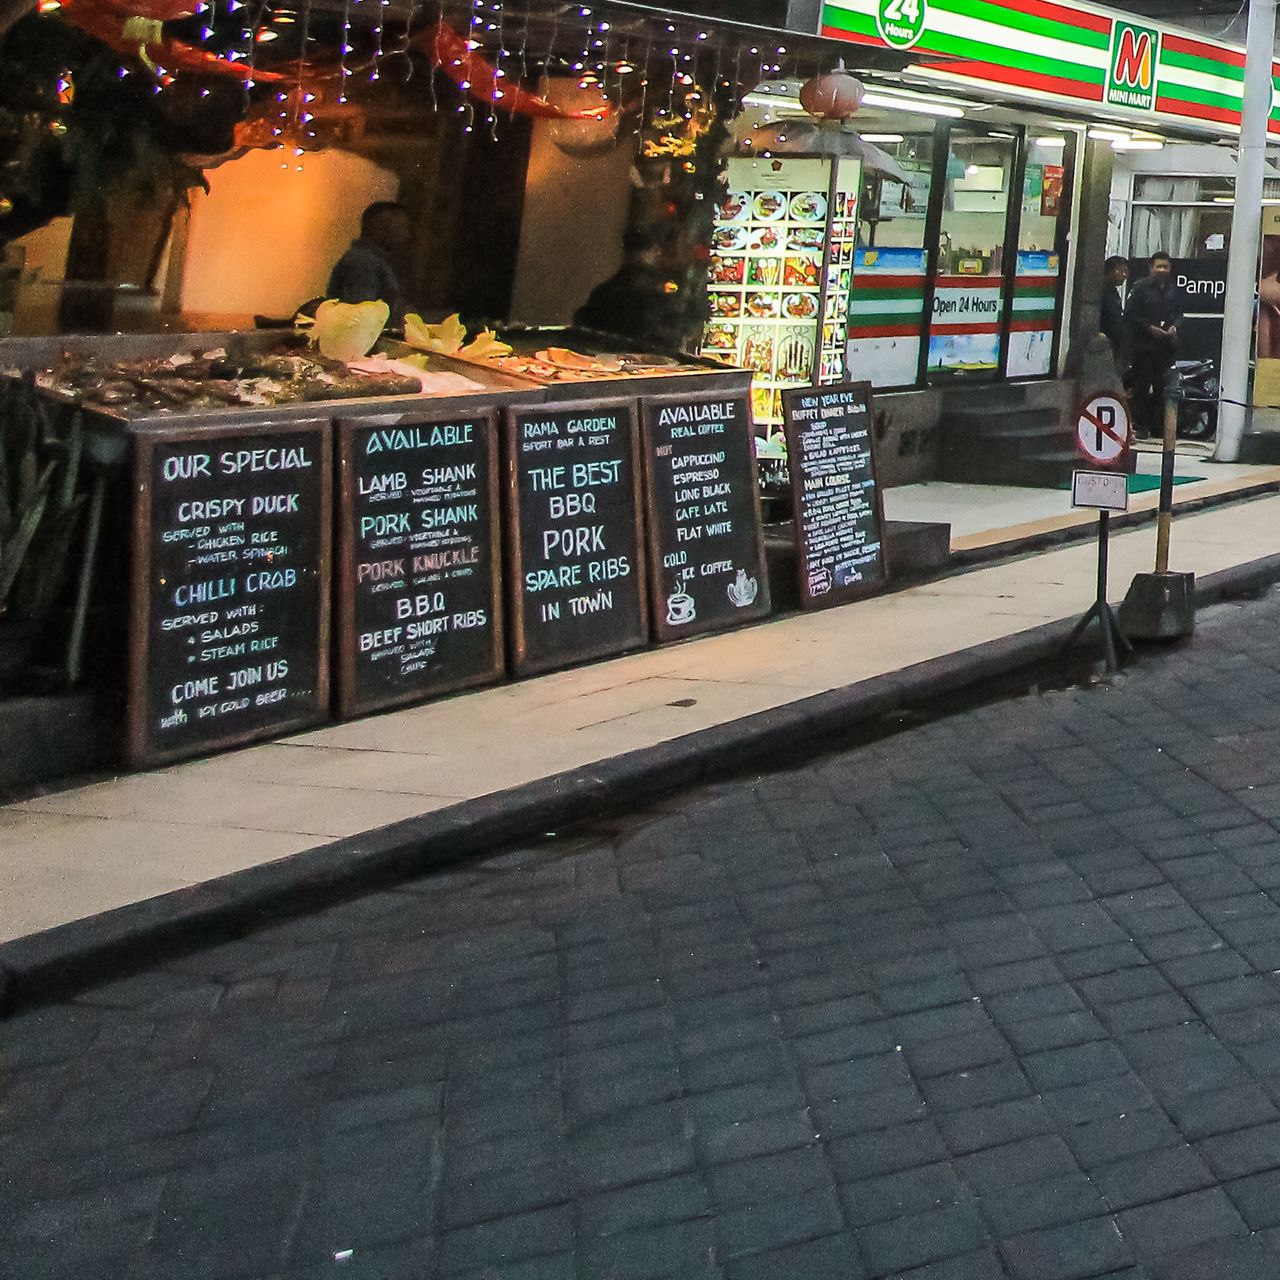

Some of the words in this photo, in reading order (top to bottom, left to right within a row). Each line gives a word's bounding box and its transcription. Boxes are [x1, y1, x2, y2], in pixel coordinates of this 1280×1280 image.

[885, 21, 914, 40] Hours
[1108, 88, 1129, 104] MINI
[1128, 91, 1152, 108] MART
[933, 296, 957, 317] Open
[959, 296, 970, 313] 24
[971, 296, 998, 313] Hours
[821, 393, 840, 407] YEAR
[839, 392, 854, 403] EVE
[658, 402, 736, 427] AVAILABLE
[523, 420, 560, 439] RAMA
[567, 416, 617, 434] GARDEN
[670, 426, 697, 439] REAL
[697, 423, 725, 436] COFFEE
[365, 424, 474, 455] AVAILABLE
[588, 434, 611, 446] REST
[163, 454, 212, 482] OUR
[220, 447, 313, 474] SPECIAL
[527, 466, 566, 492] THE
[572, 459, 622, 488] BEST
[358, 471, 408, 495] LAMB
[422, 463, 476, 486] SHANK
[673, 468, 720, 486] ESPRESSO
[804, 477, 824, 492] MAIN
[675, 488, 701, 504] LONG
[702, 482, 732, 498] BLACK
[177, 498, 246, 523] CRISPY
[252, 493, 300, 516] DUCK
[549, 491, 596, 520] BBQ
[675, 505, 701, 522] CAFE
[704, 500, 728, 516] LATE
[162, 526, 211, 543] SERVED
[219, 521, 245, 534] WITH
[360, 512, 411, 540] PORK
[421, 504, 478, 529] SHANK
[676, 525, 703, 543] FLAT
[705, 520, 733, 537] WHITE
[251, 531, 278, 545] RICE
[542, 524, 606, 561] PORK
[357, 558, 405, 584] PORK
[413, 546, 480, 574] KNUCKLE
[663, 550, 688, 568] COLD
[682, 566, 696, 581] ICE
[700, 559, 734, 577] COFFEE
[525, 564, 582, 593] SPARE
[588, 555, 631, 583] RIBS
[174, 577, 236, 607] CHILLI
[246, 568, 297, 593] CRAB
[541, 601, 561, 623] IN
[568, 590, 613, 616] TOWN
[161, 611, 219, 631] SERVED
[201, 621, 260, 643] SALADS
[360, 626, 403, 652] BEEF
[406, 615, 450, 640] SHORT
[452, 609, 487, 631] RIBS
[200, 642, 245, 661] STEAM
[251, 636, 279, 652] RICE
[171, 676, 219, 705] COME
[226, 665, 262, 691] JOIN
[266, 659, 289, 681] US
